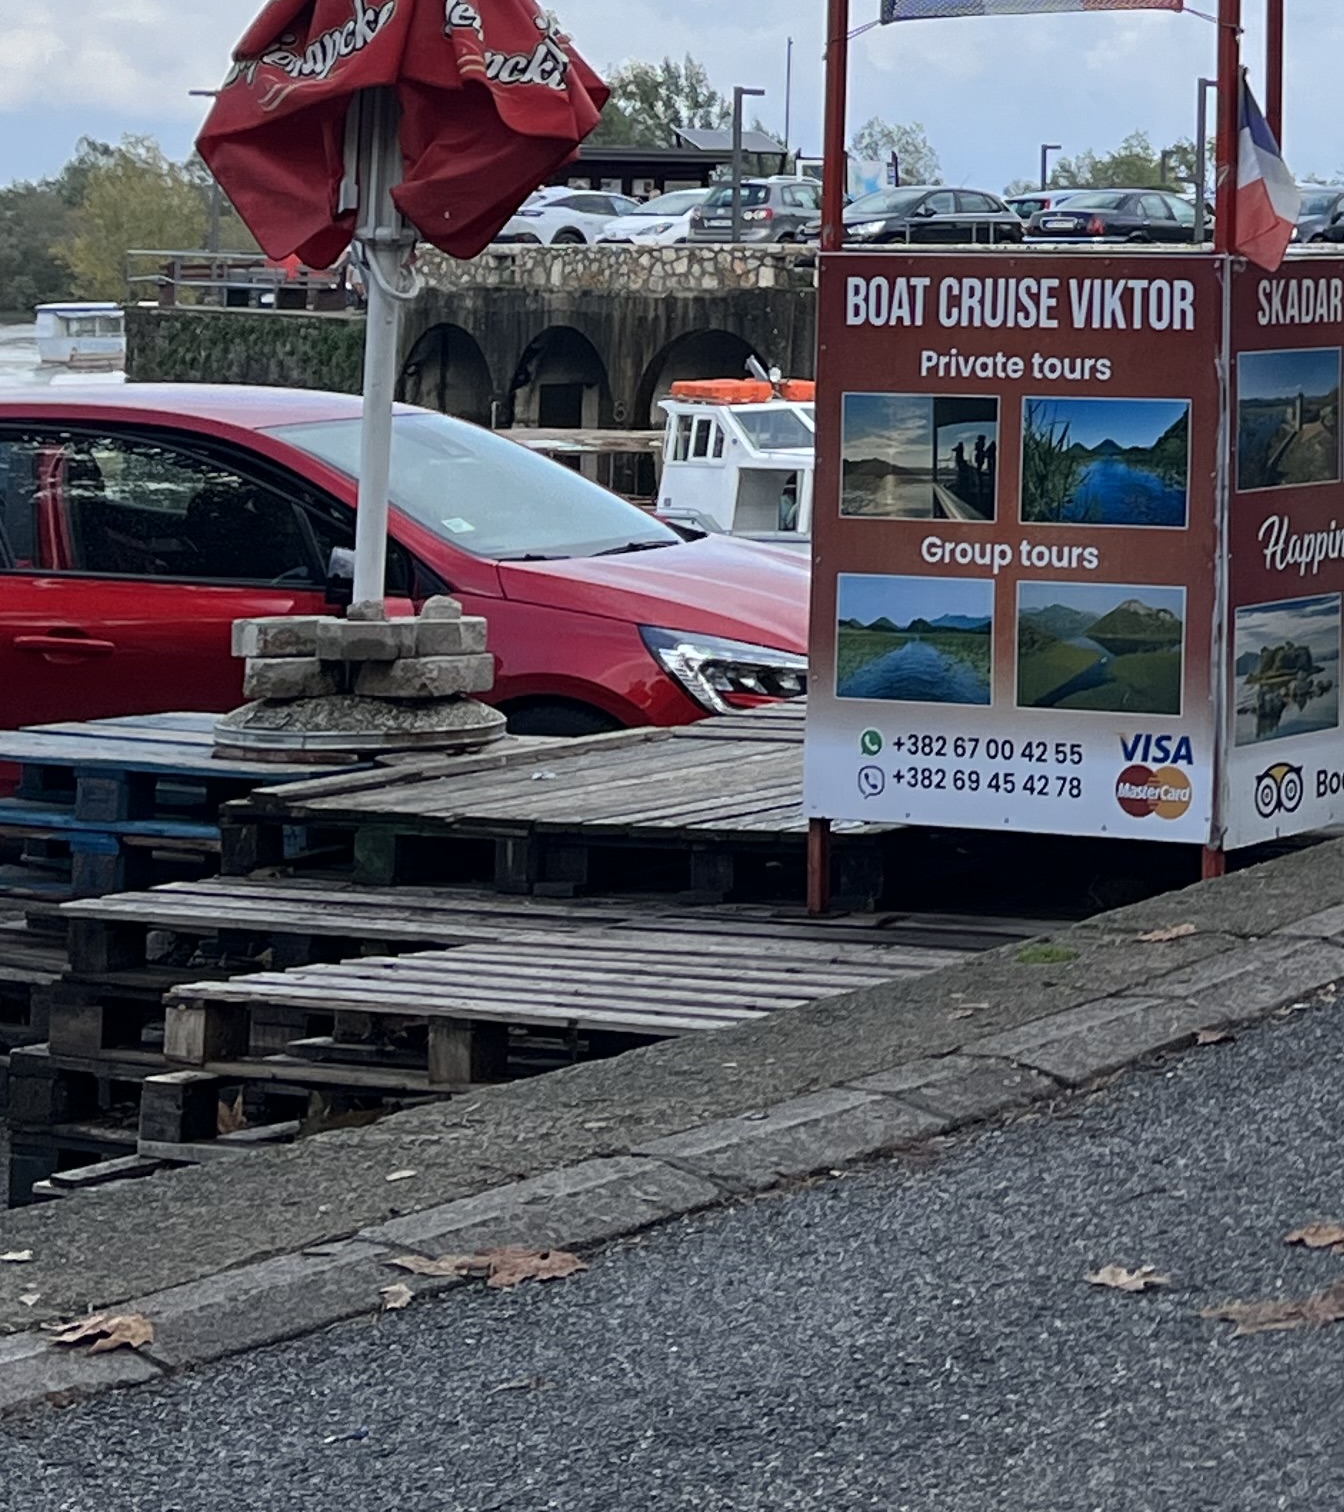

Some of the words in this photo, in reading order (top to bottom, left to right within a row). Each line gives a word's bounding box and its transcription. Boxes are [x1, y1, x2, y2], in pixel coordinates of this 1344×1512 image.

[846, 276, 930, 327] BOAT
[938, 277, 1059, 329] CRUISE
[1069, 278, 1195, 331] VIKTOR
[1257, 277, 1343, 326] SKADAR
[921, 348, 1025, 380] Private
[1031, 353, 1112, 382] tours
[921, 535, 1013, 575] Group
[1019, 540, 1099, 570] tours
[893, 734, 947, 757] +382
[953, 737, 980, 759] 67
[986, 738, 1014, 760] 00
[1021, 741, 1048, 763] 42
[1055, 743, 1083, 765] 55
[1118, 732, 1194, 765] VISA
[893, 767, 946, 789] +382
[953, 770, 980, 791] 69
[987, 772, 1016, 794] 45
[1022, 775, 1049, 796] 42
[1055, 776, 1082, 798] 78
[1117, 782, 1191, 802] MasterCard
